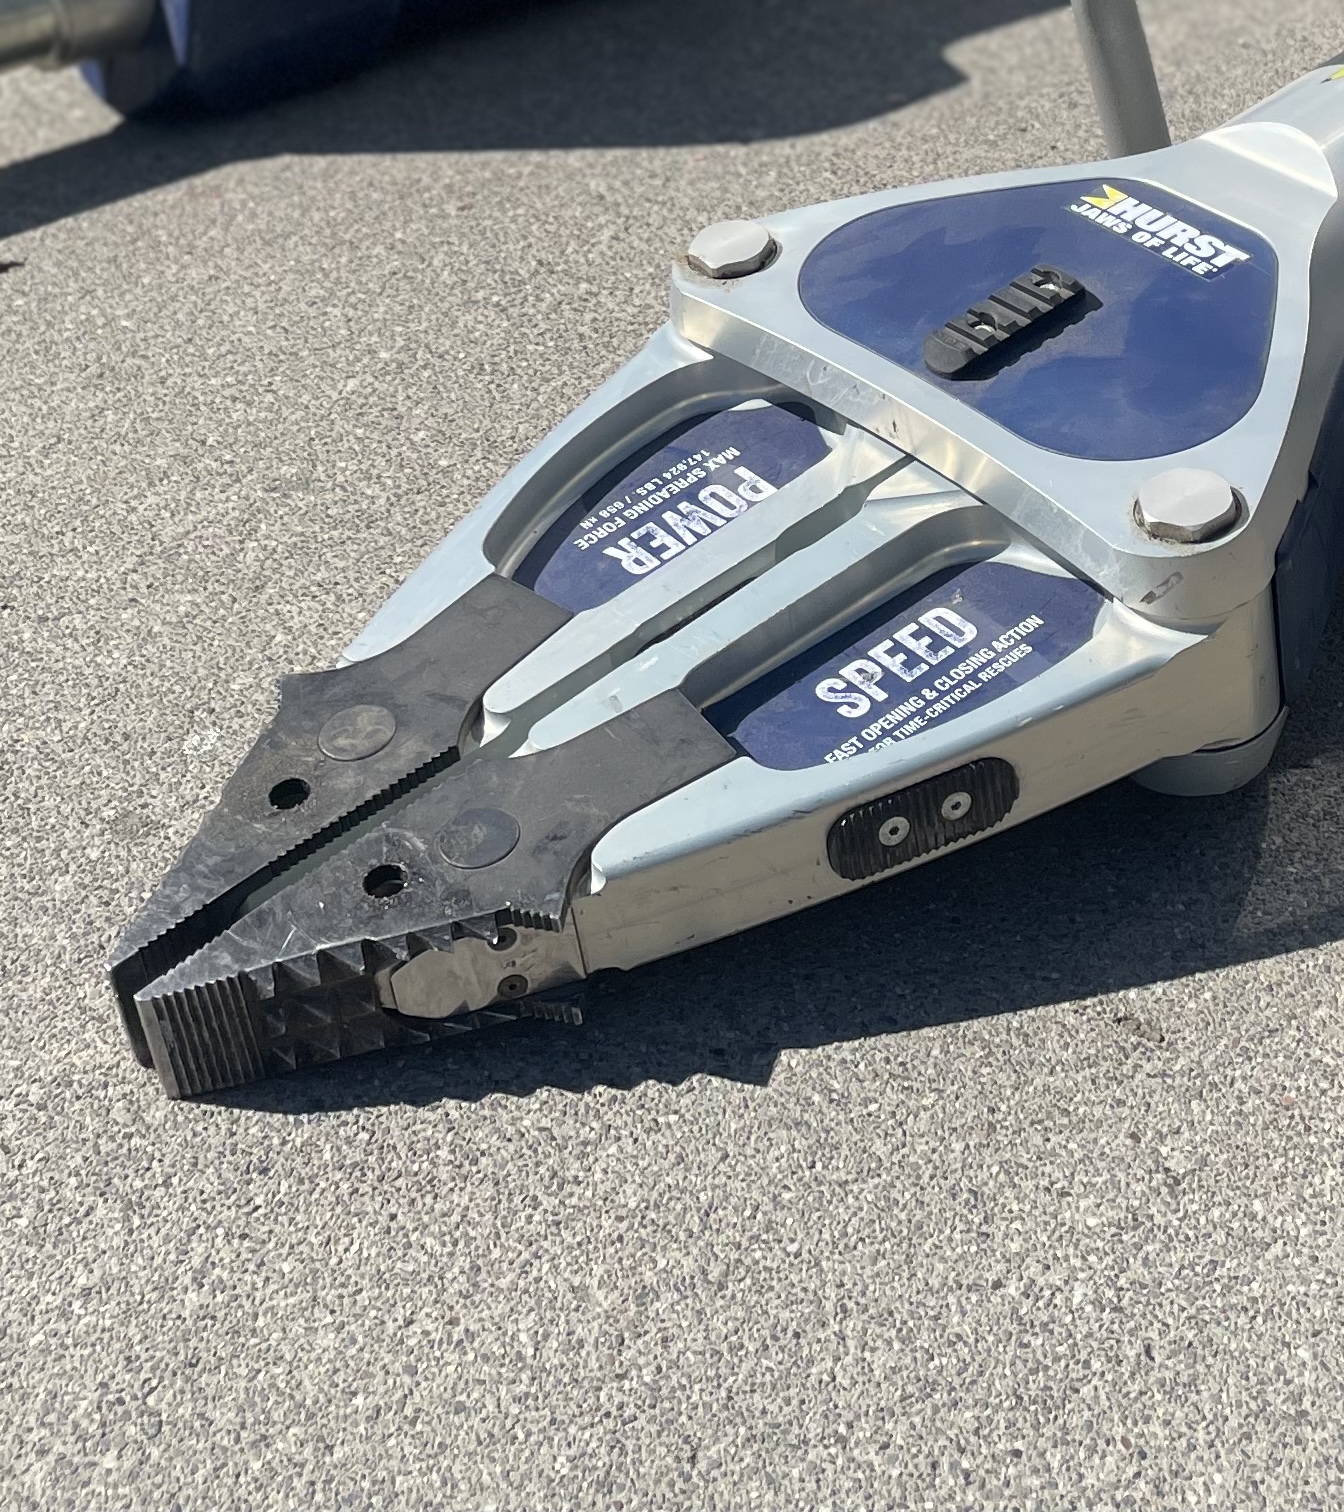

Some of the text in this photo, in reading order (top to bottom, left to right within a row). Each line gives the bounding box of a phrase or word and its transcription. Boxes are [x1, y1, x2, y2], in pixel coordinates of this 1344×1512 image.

[1070, 203, 1214, 275] JAWS OF LIFE
[1106, 196, 1251, 268] HURST
[573, 447, 741, 551] MAX SPREADING FORCE
[632, 478, 664, 496] LBS.
[663, 449, 712, 480] 147,924
[598, 502, 626, 519] 658
[603, 465, 778, 575] POWER
[815, 607, 979, 718] SPEED
[824, 614, 1045, 764] FAST OPENING & CLOSING ACTION
[892, 678, 982, 740] TIME-CRITICAL
[980, 643, 1033, 683] RESCUES
